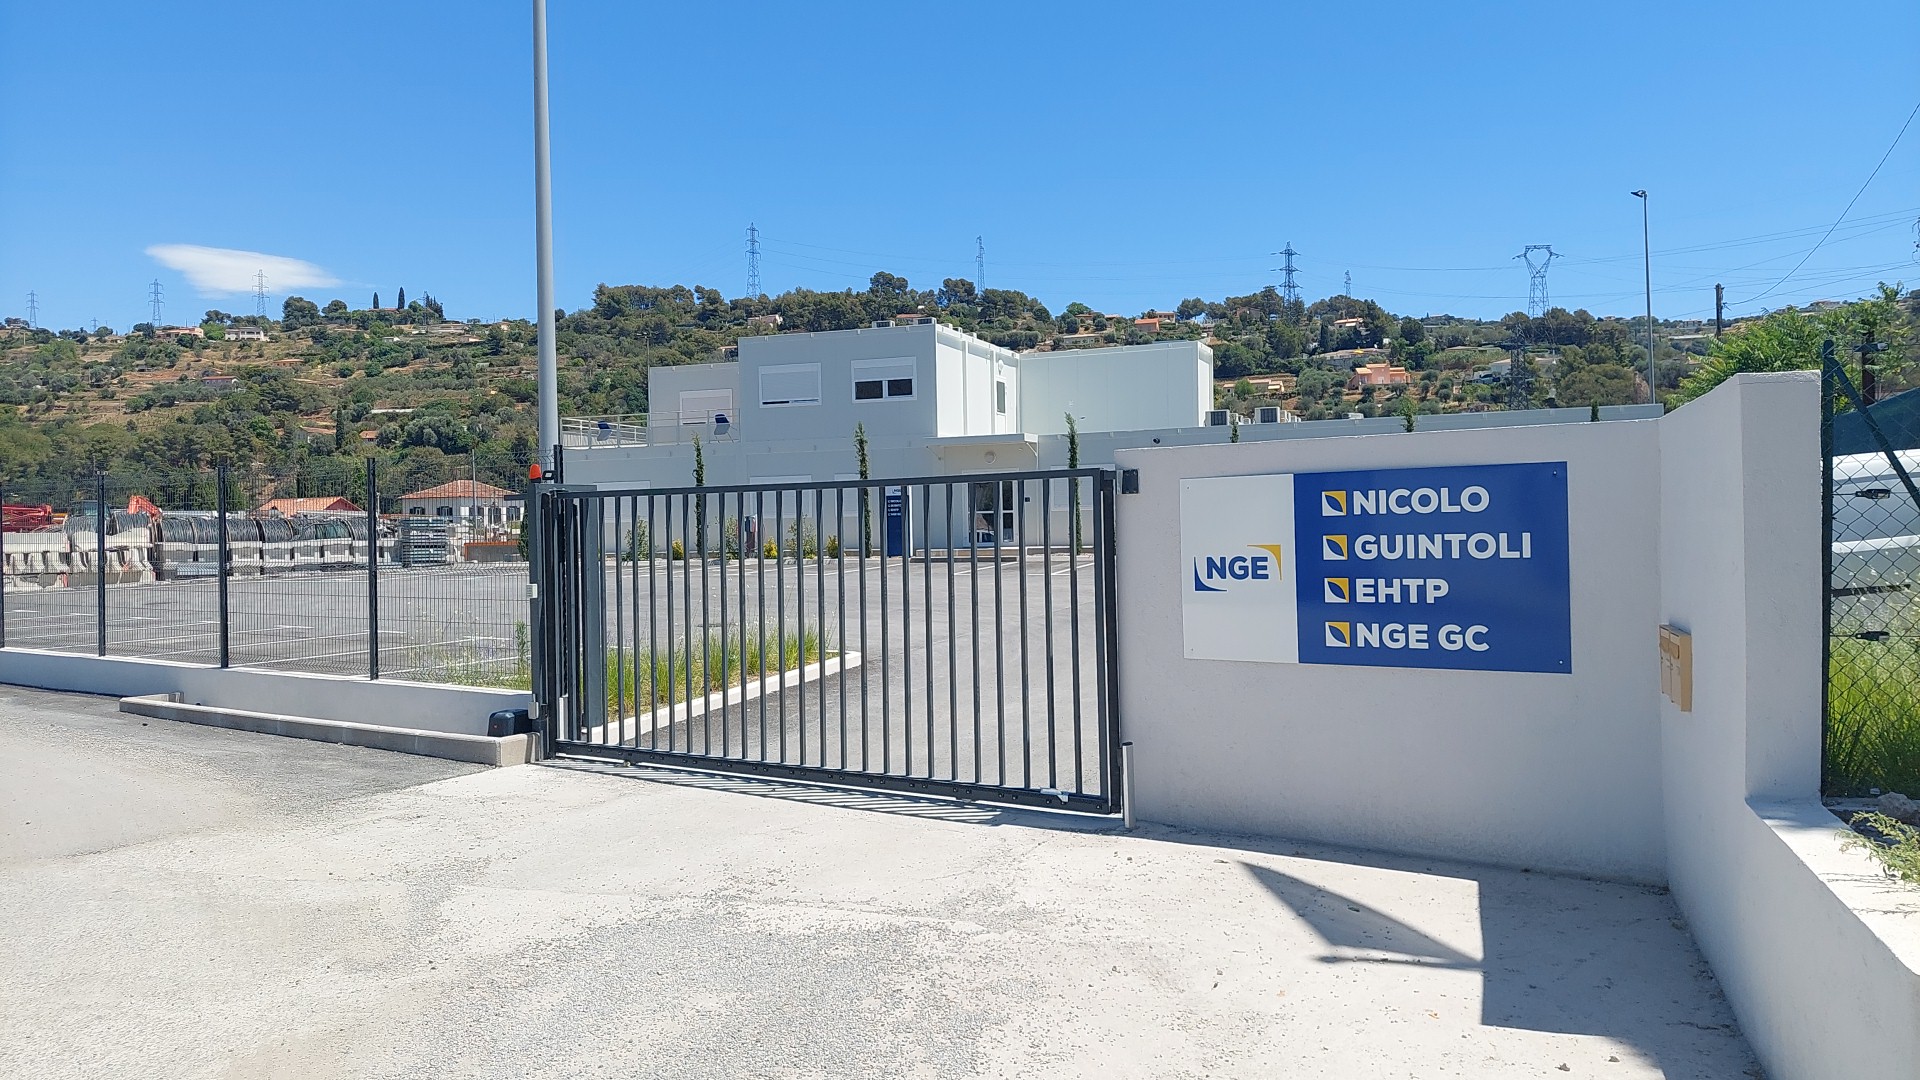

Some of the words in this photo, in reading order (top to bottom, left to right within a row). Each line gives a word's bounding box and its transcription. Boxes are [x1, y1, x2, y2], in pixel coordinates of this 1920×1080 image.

[1353, 485, 1490, 515] NICOLO
[1354, 532, 1532, 560] GUINTOLI
[1206, 555, 1270, 581] NGE
[1355, 578, 1449, 604] EHTP
[1356, 622, 1429, 650] NGE
[1437, 624, 1490, 652] GC
